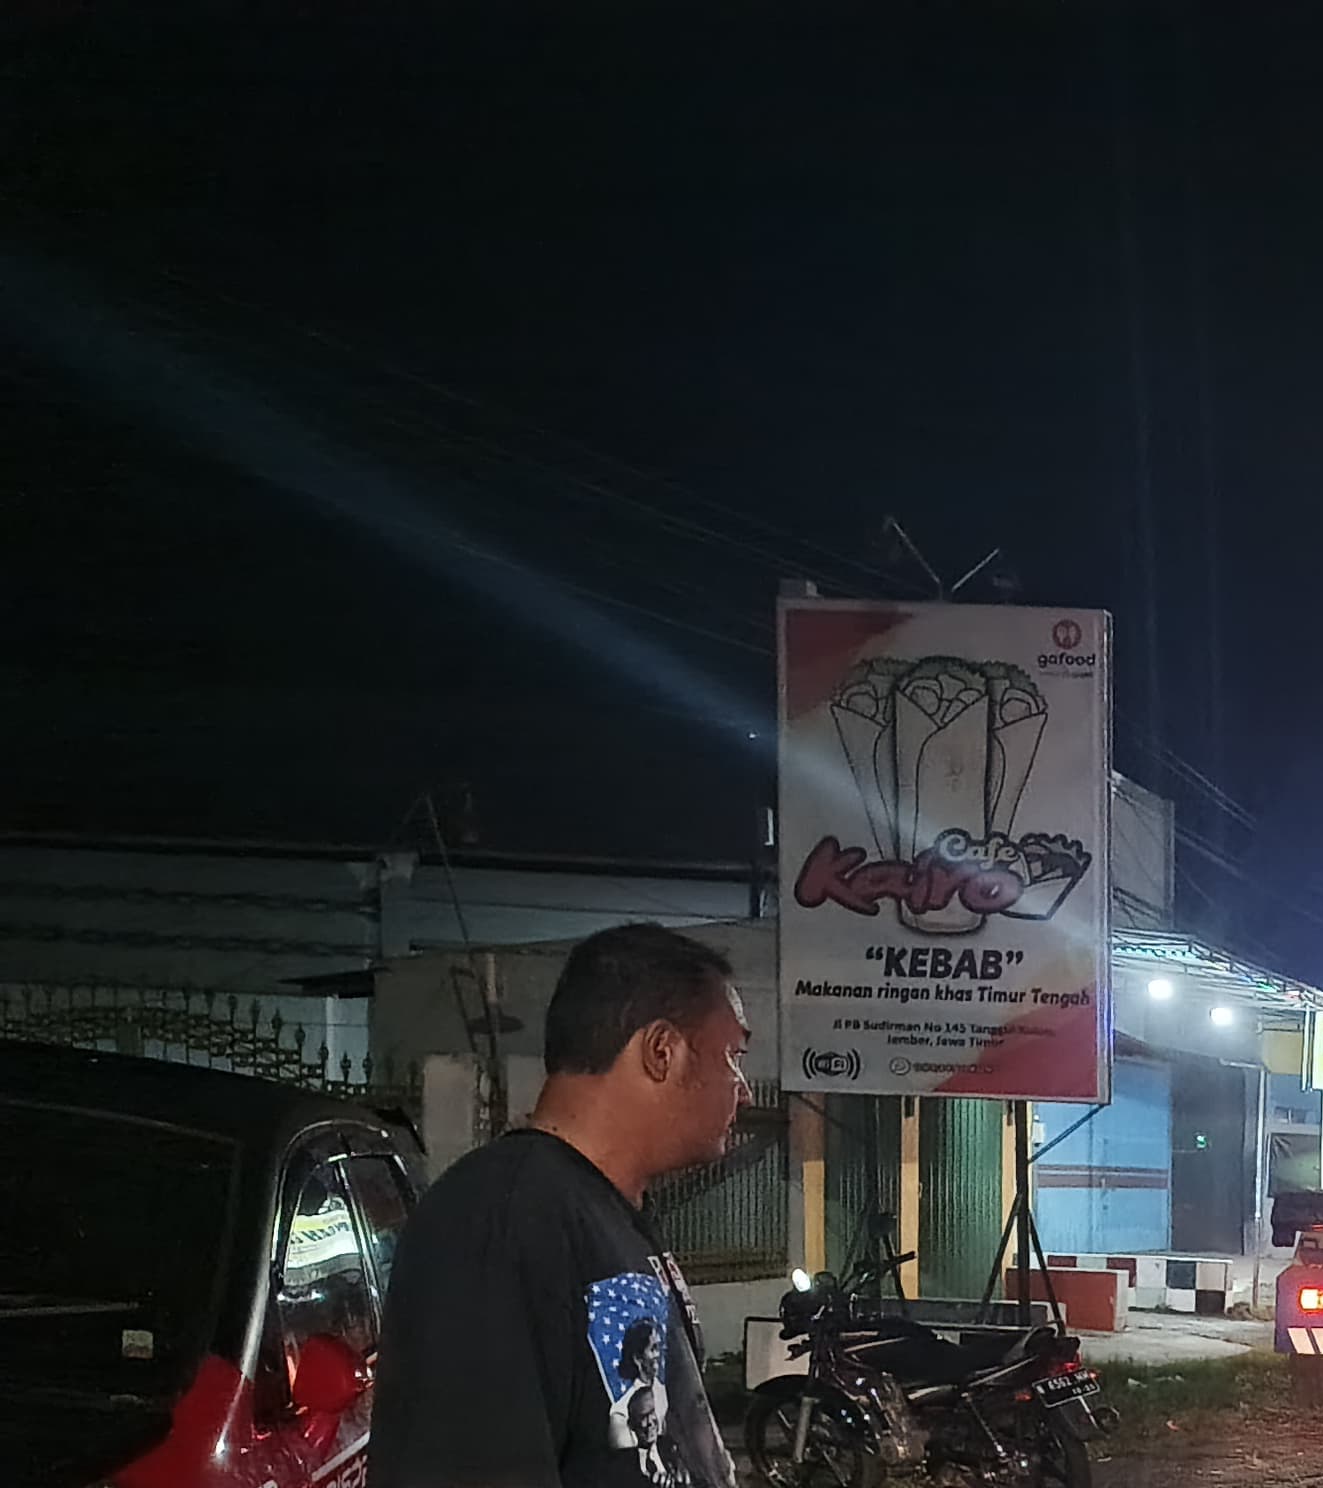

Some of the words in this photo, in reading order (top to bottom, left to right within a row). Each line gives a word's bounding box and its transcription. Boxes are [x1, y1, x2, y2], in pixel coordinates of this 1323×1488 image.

[937, 832, 1020, 871] Cafe
[794, 979, 873, 999] Makanan
[876, 981, 933, 1004] ringan
[934, 983, 973, 1003] khas
[976, 985, 1026, 1005] Timur
[1030, 988, 1091, 1008] Tengah
[863, 1020, 921, 1033] Sudirman
[924, 1022, 942, 1033] No
[943, 1022, 967, 1034] 145
